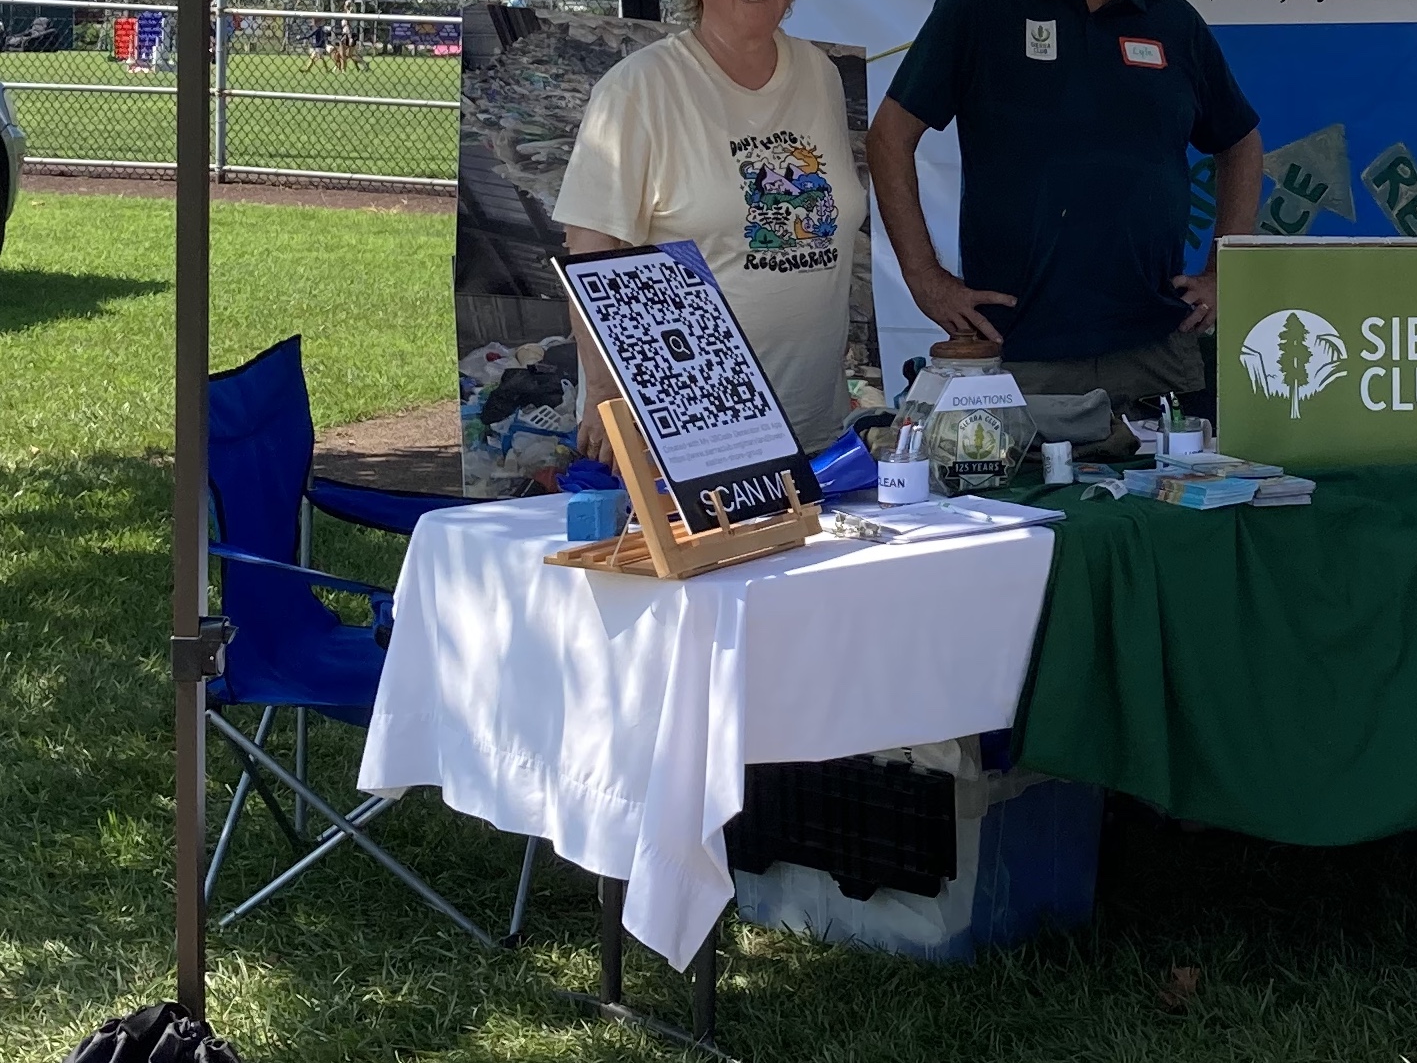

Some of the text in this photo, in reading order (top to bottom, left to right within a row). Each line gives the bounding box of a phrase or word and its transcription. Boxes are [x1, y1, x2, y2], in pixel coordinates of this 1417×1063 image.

[952, 394, 1013, 406] DONATIONS
[955, 462, 1000, 473] 125 YEARS
[877, 476, 905, 488] LEAN
[700, 476, 766, 517] SCAN
